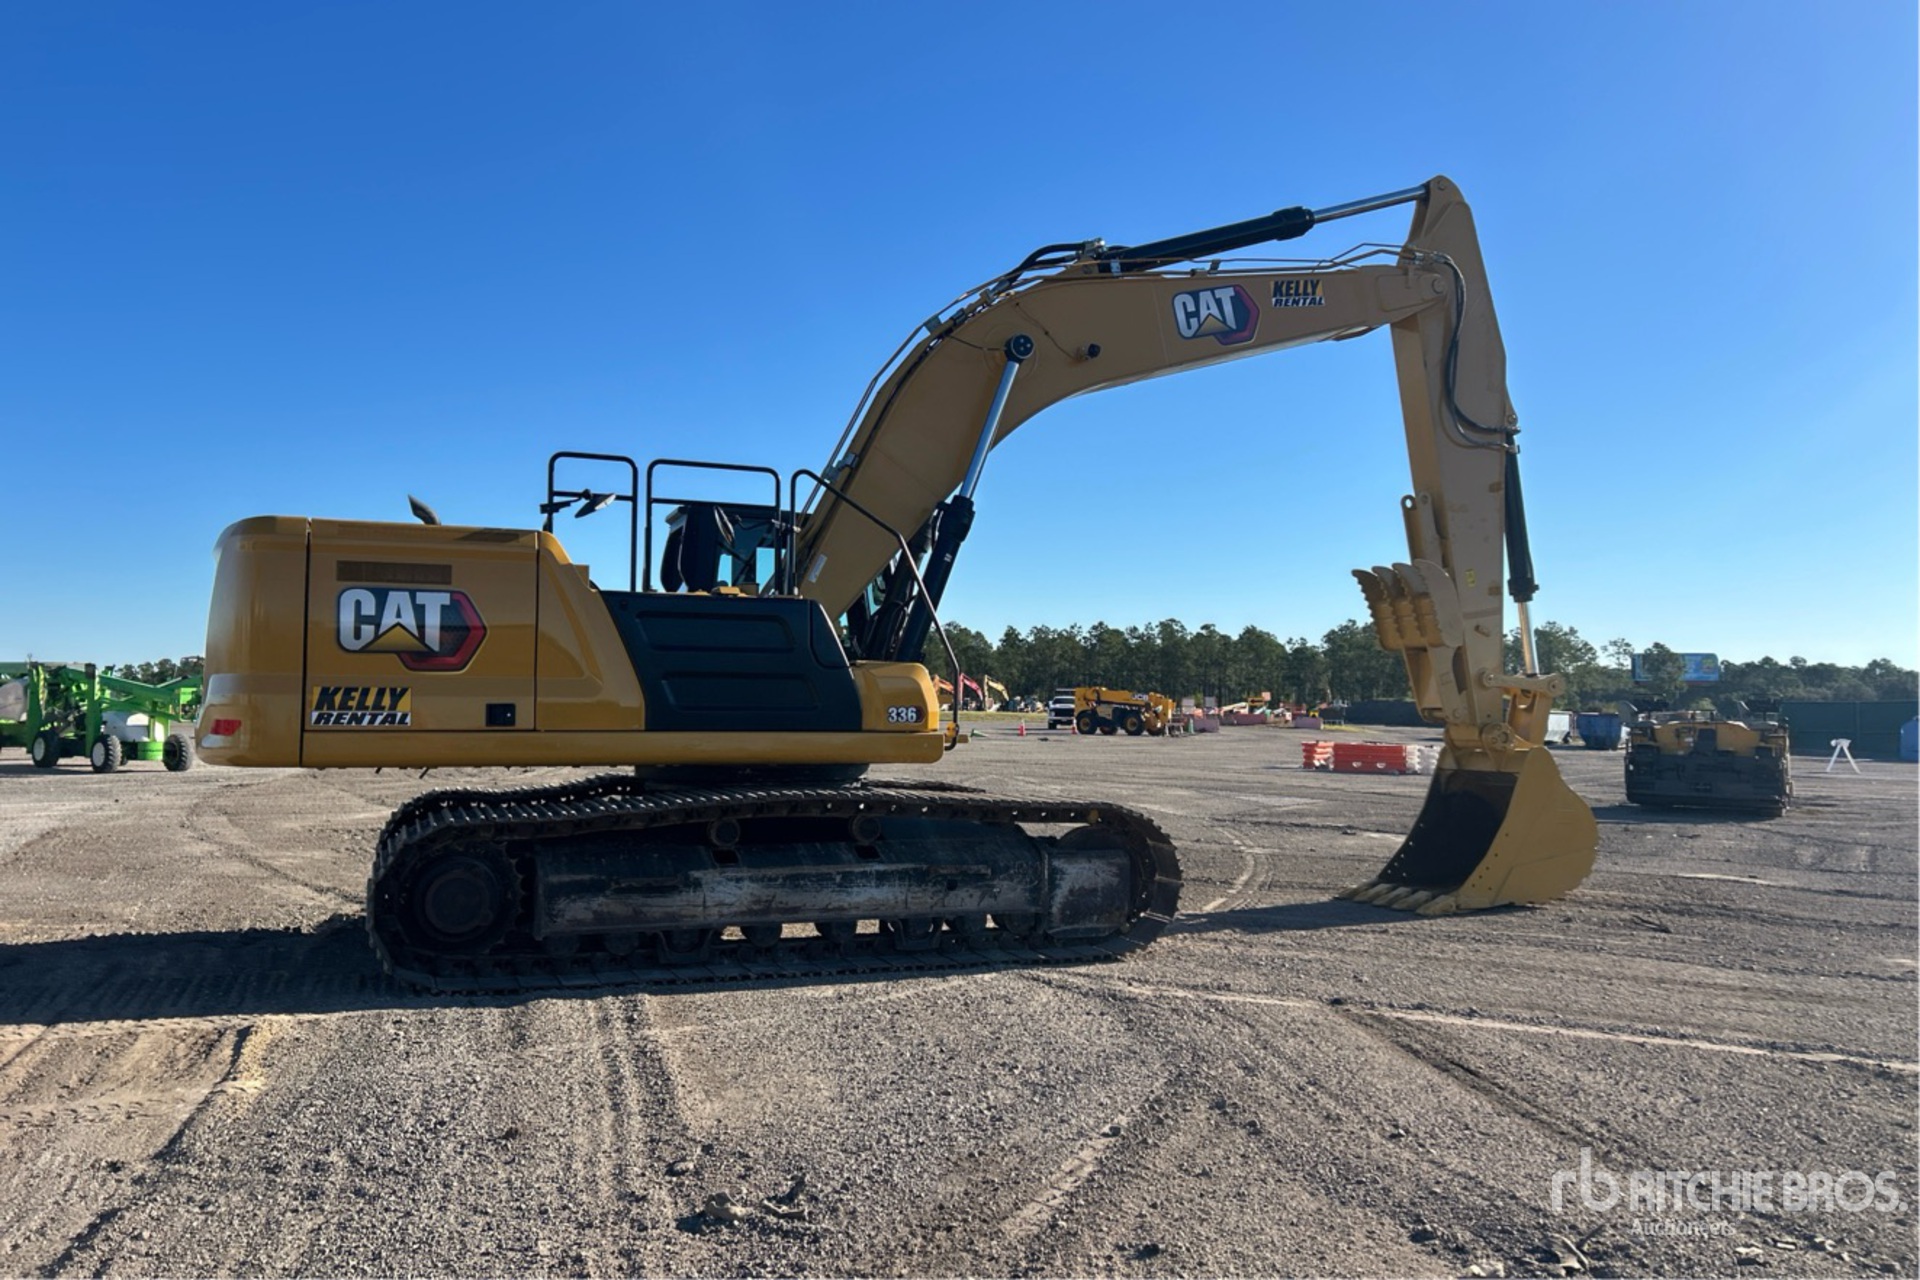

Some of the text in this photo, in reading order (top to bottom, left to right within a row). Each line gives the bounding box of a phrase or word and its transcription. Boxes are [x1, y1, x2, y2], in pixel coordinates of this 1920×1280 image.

[1273, 279, 1320, 297] KELLY
[1273, 297, 1323, 307] RENTAL
[1173, 286, 1237, 338] CAT
[339, 588, 451, 652] CAT
[314, 687, 409, 711] KELLY
[1131, 693, 1149, 701] JCB
[313, 712, 409, 725] RENTAL
[888, 706, 917, 723] 336
